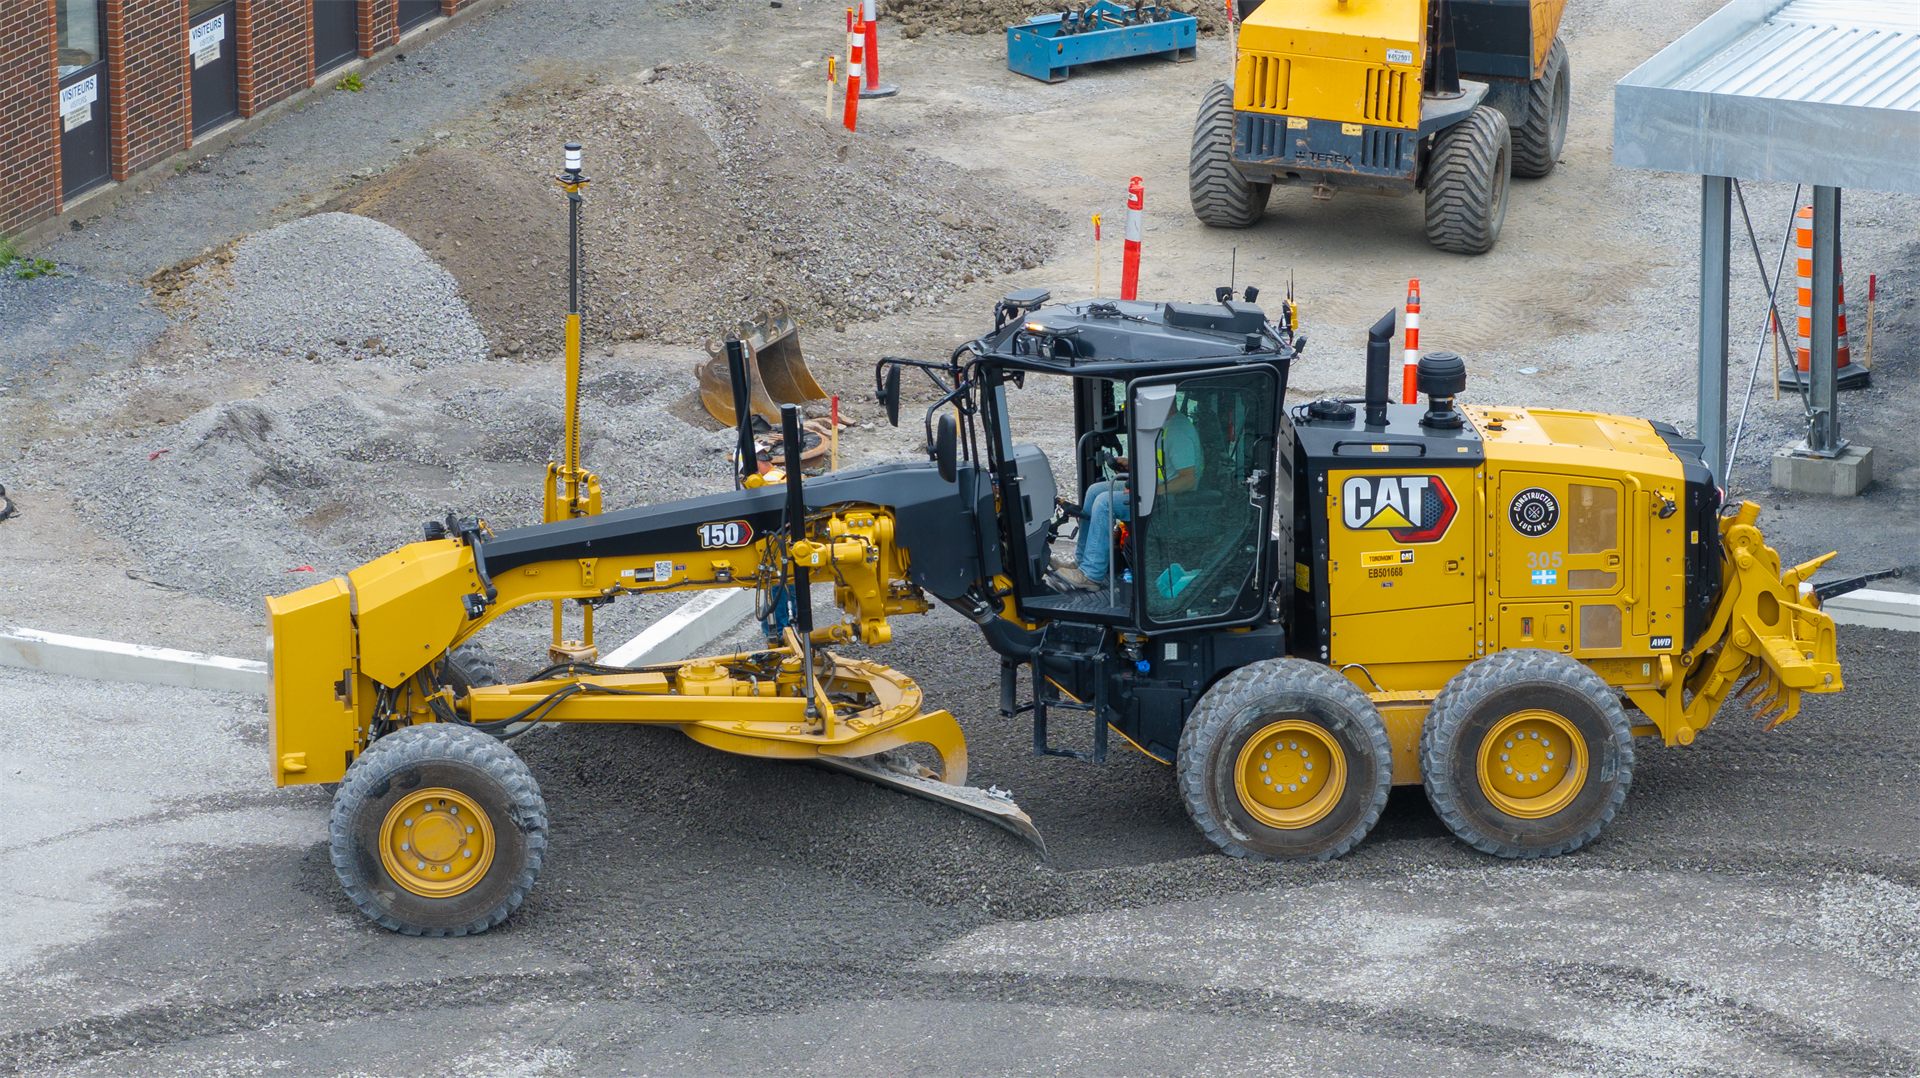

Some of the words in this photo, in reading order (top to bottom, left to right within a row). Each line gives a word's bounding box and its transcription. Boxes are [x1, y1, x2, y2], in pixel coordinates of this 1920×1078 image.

[191, 17, 222, 40] VISITEURS
[62, 78, 94, 103] VISITEURS
[1309, 151, 1352, 164] TEREX
[1343, 476, 1428, 529] CAT
[1513, 491, 1555, 512] CONSTRUCTION
[700, 522, 739, 546] 150
[1518, 520, 1532, 532] LUC
[1533, 522, 1550, 532] INC.
[1401, 552, 1413, 561] CAT
[1527, 551, 1563, 569] 305
[1368, 567, 1403, 579] EB501668
[1651, 638, 1671, 647] AWD
